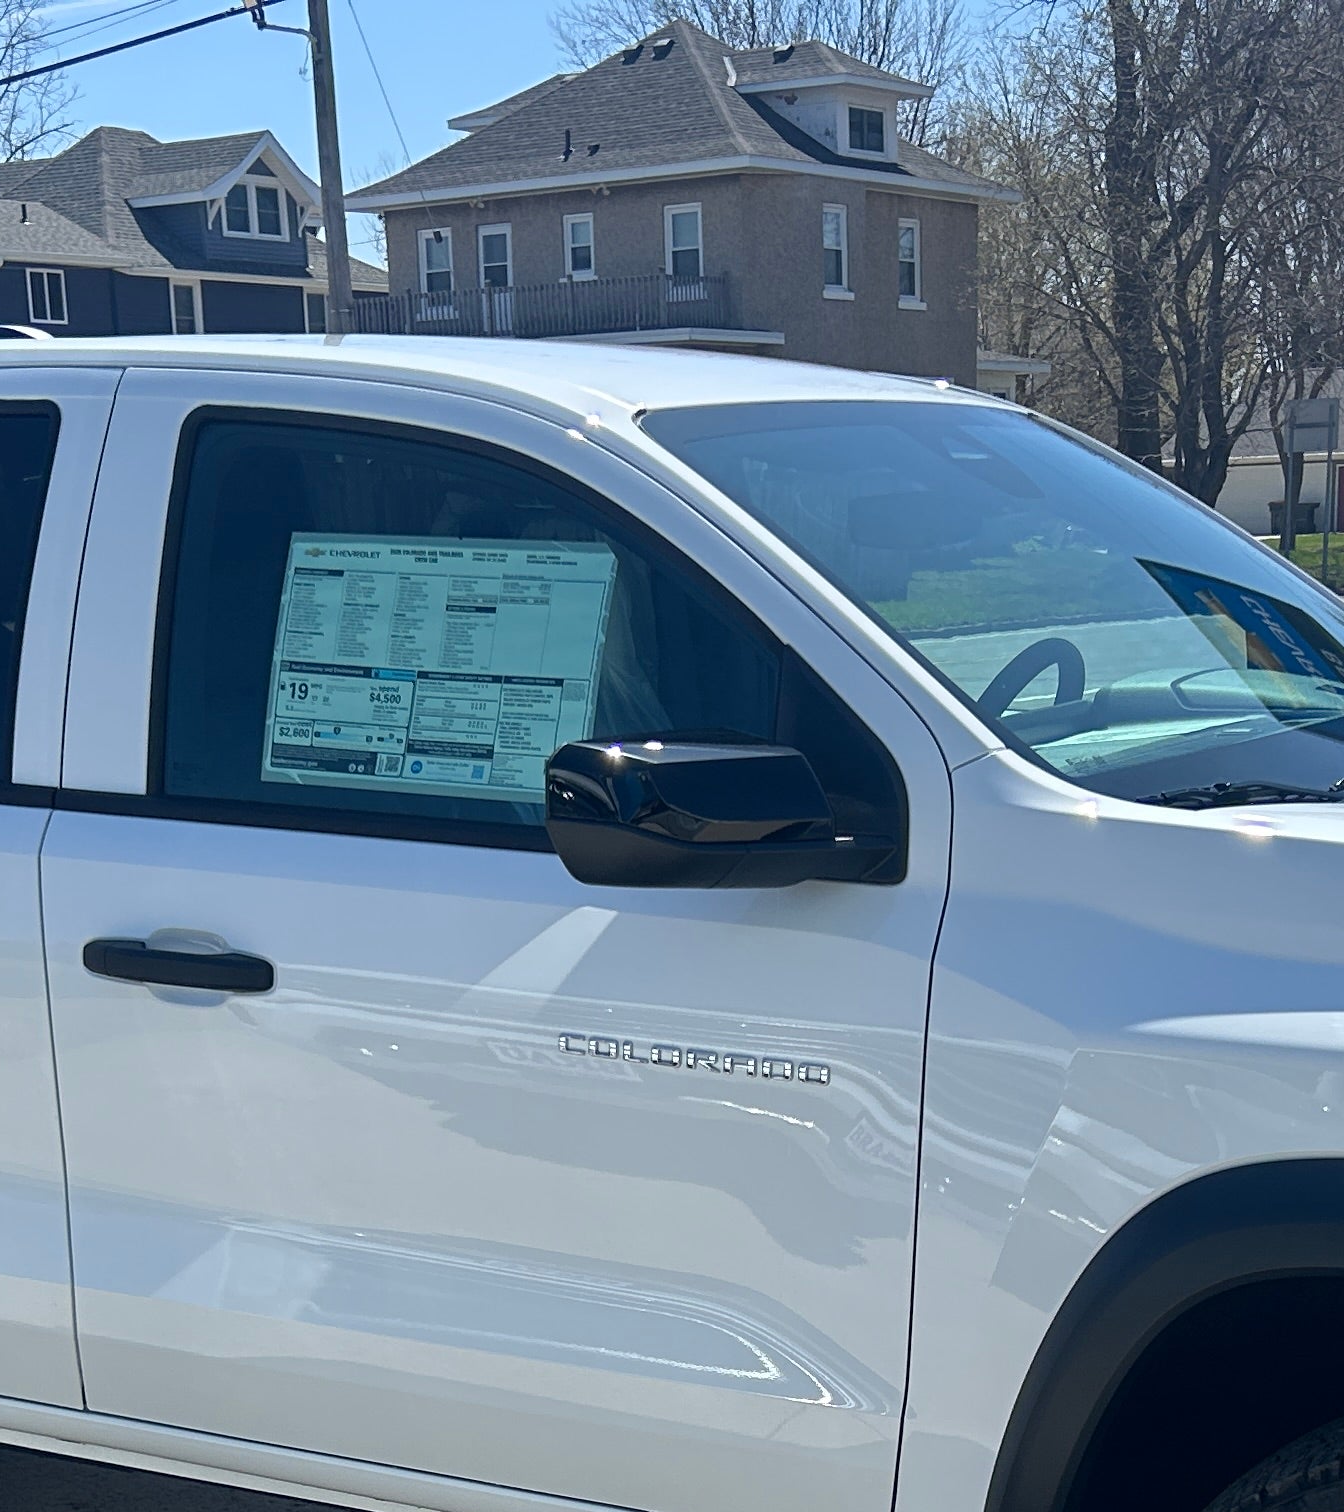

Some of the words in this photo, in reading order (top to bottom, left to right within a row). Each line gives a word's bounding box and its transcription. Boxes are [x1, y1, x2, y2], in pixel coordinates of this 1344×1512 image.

[329, 549, 381, 559] CHEVROLET
[289, 682, 309, 700] 19
[369, 692, 402, 705] $4,500
[557, 1031, 832, 1087] COLORADO
